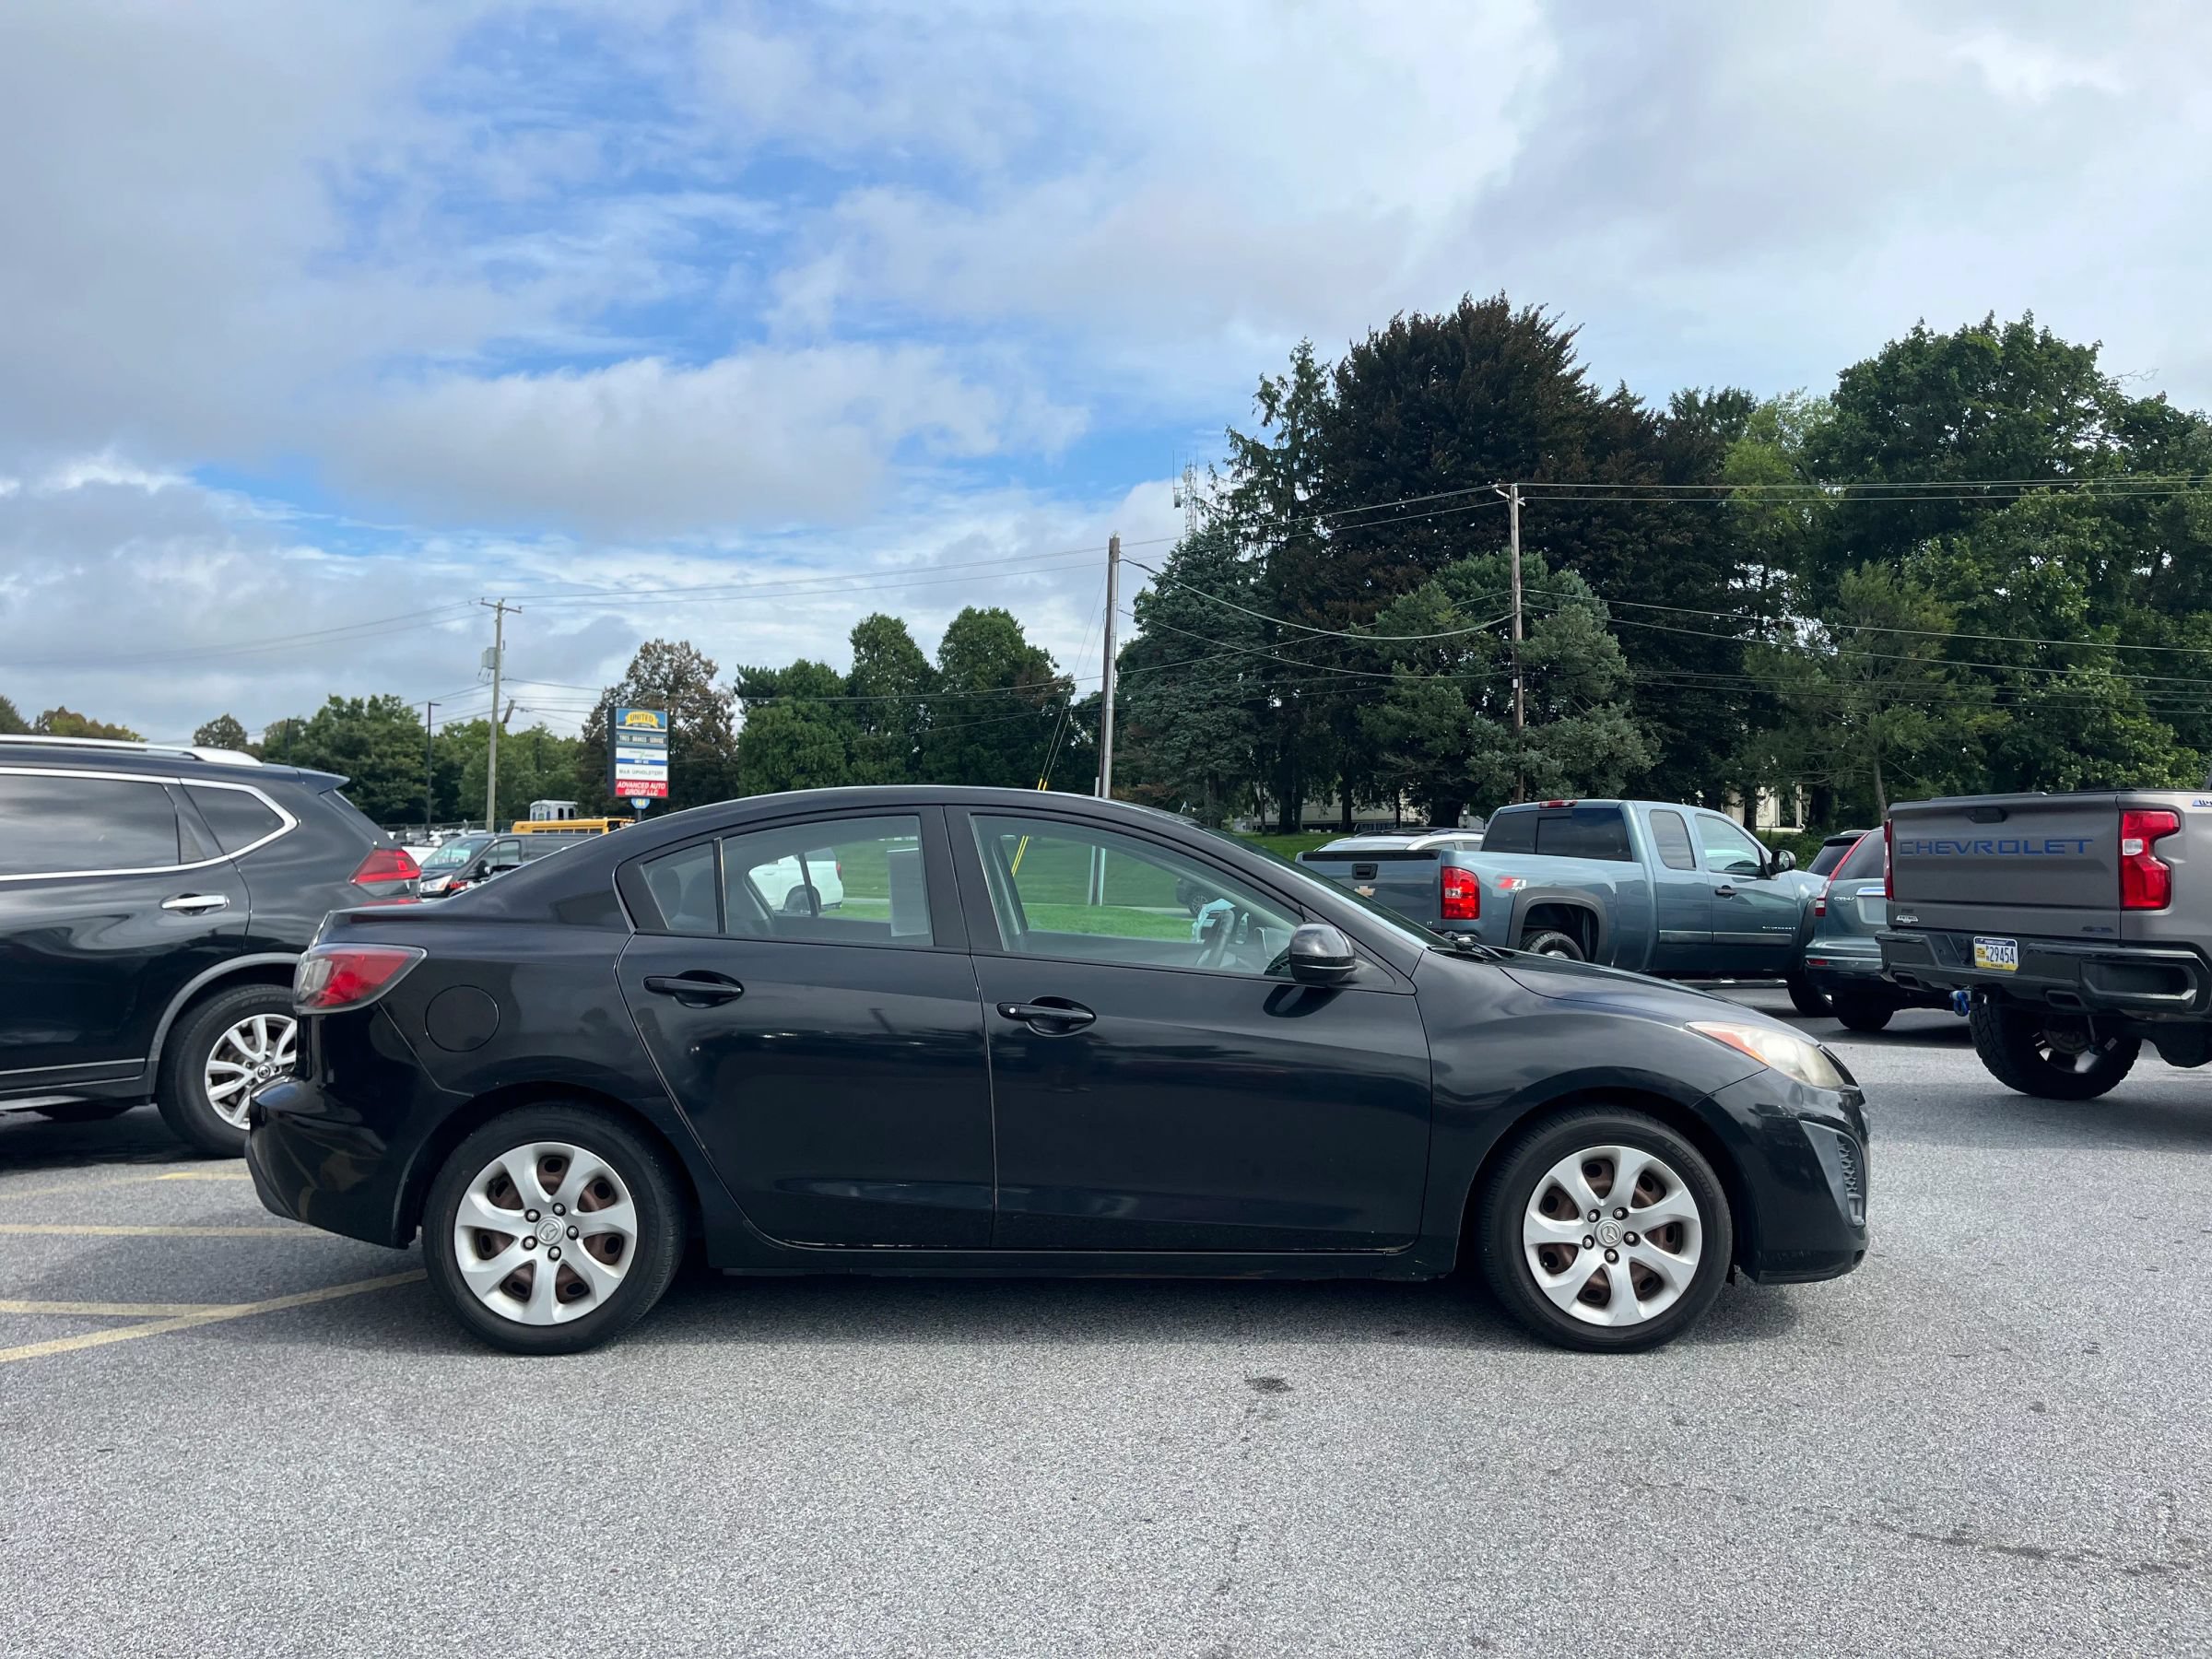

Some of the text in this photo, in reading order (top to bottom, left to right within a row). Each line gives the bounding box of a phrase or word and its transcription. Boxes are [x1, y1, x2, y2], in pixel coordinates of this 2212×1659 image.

[629, 713, 653, 723] UNITED
[617, 781, 650, 789] ADVANCED
[1900, 839, 2094, 855] CHEVROLET
[1989, 946, 2016, 965] 29454
